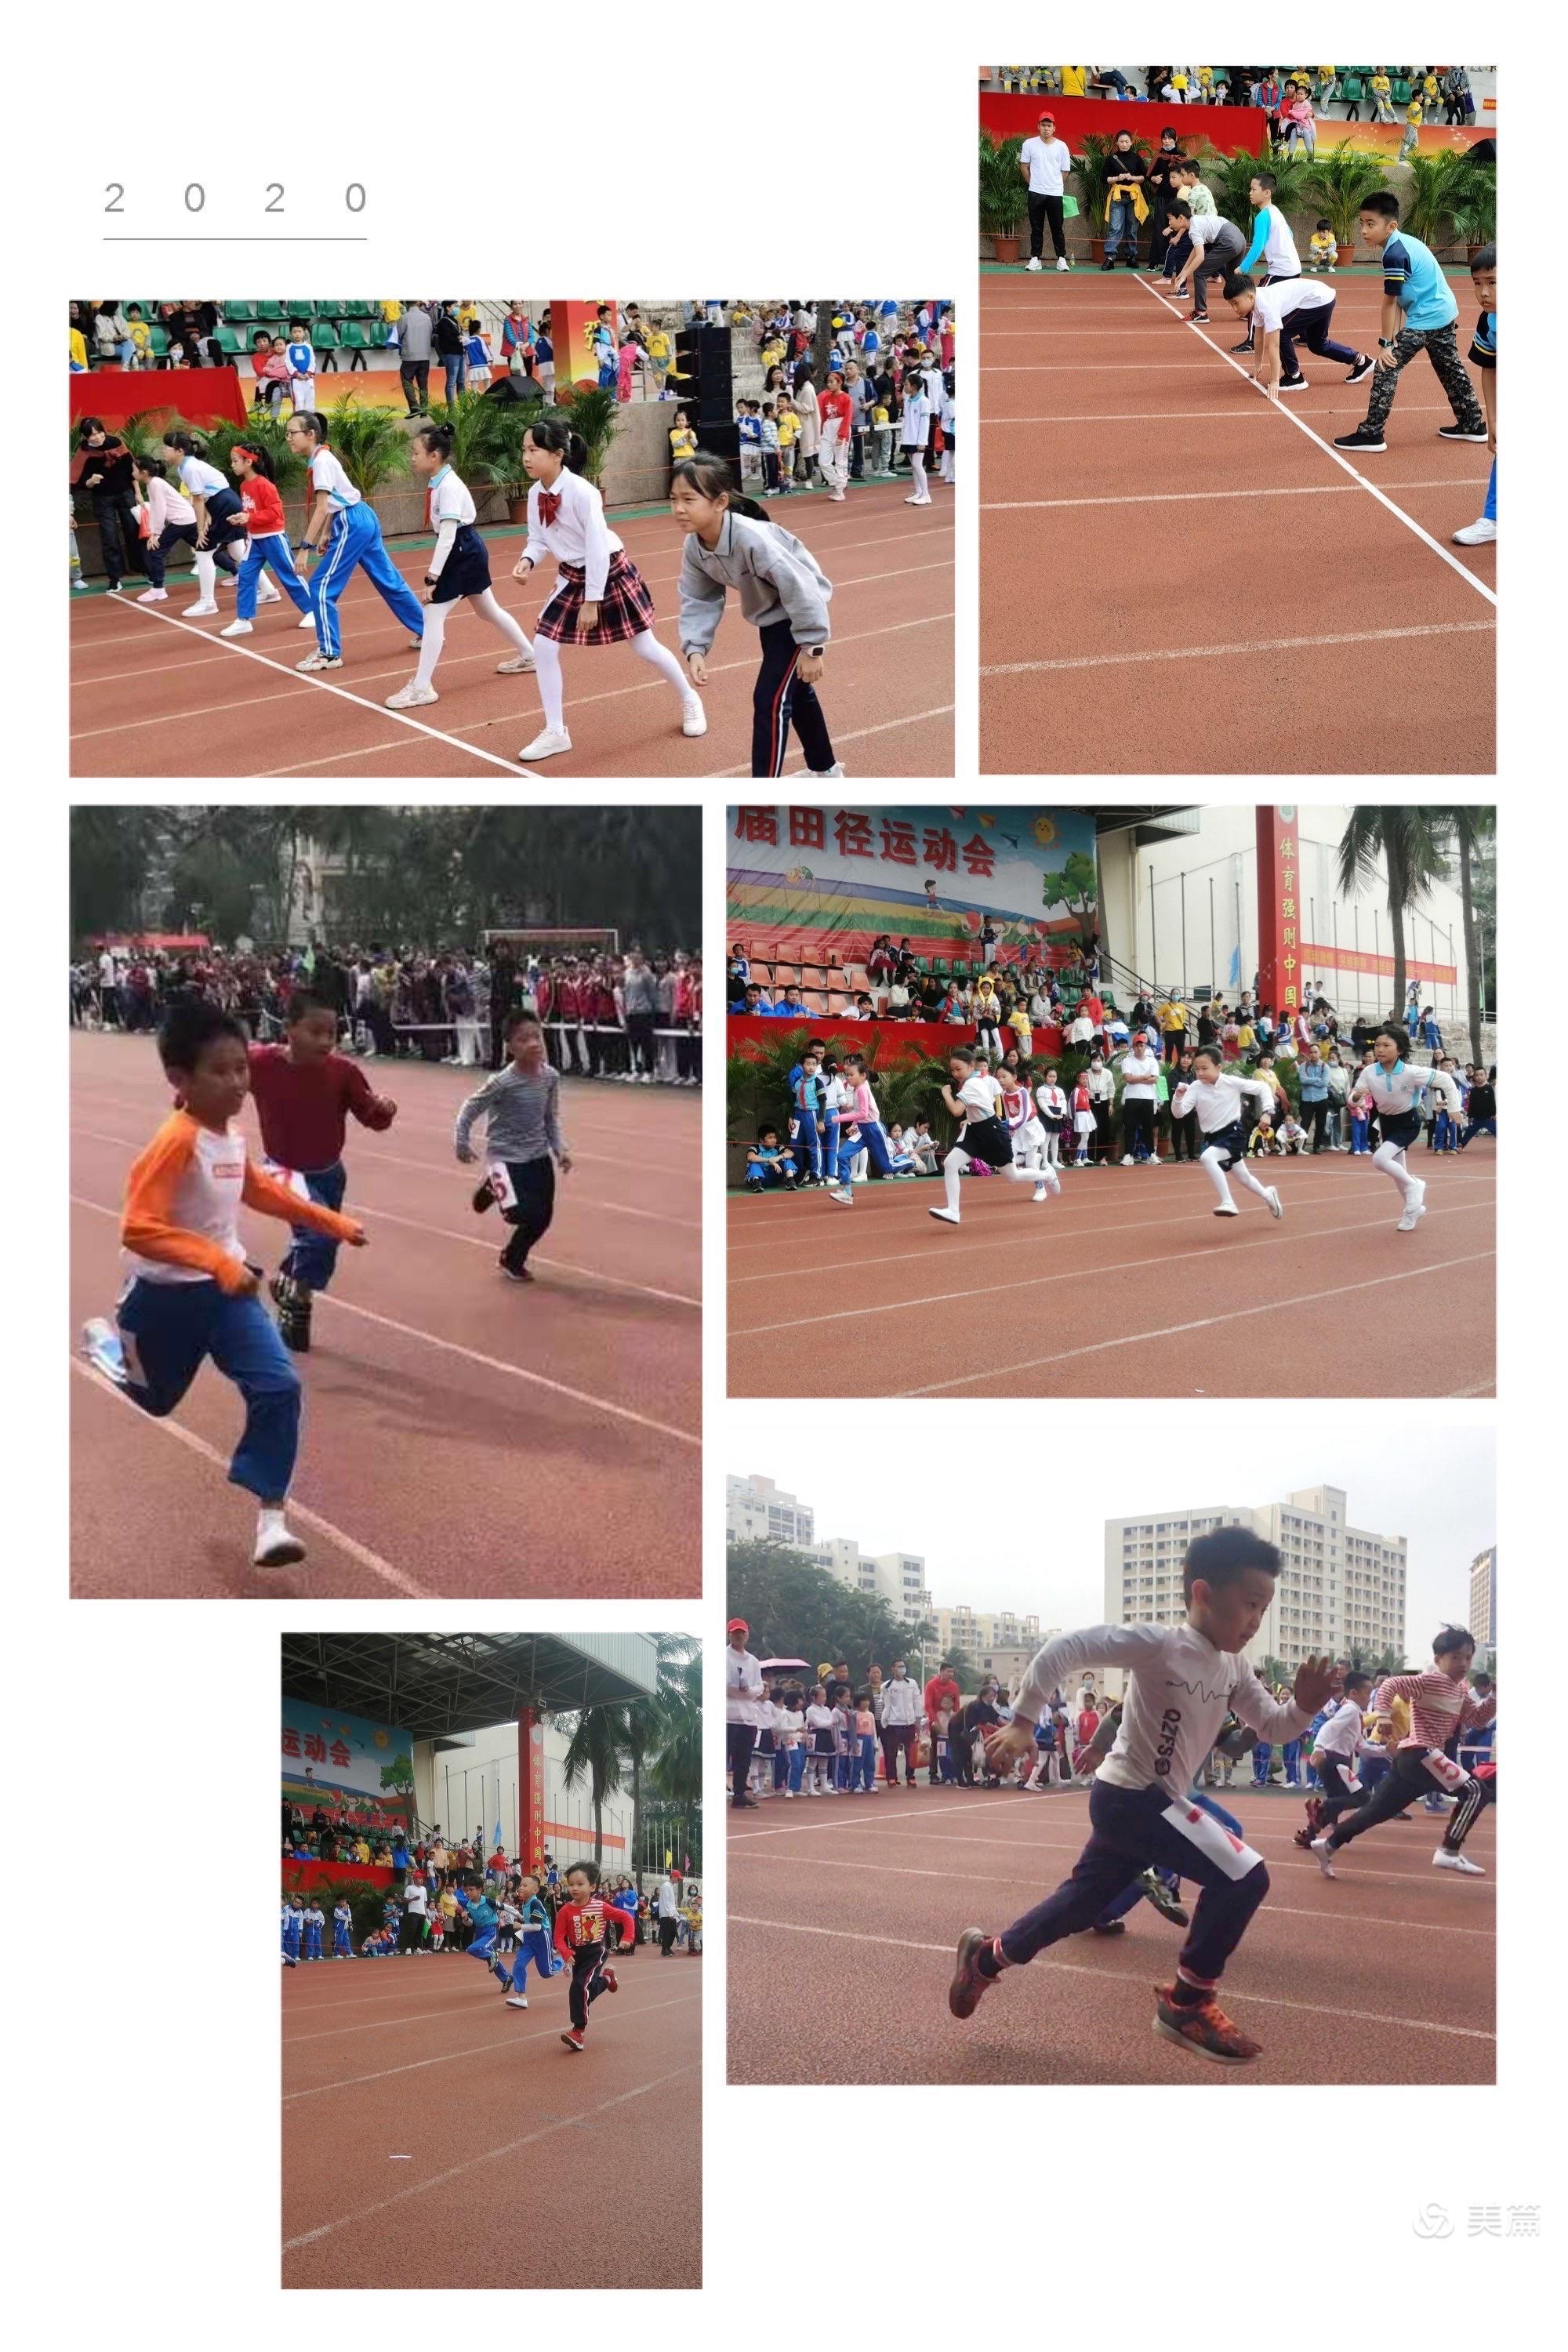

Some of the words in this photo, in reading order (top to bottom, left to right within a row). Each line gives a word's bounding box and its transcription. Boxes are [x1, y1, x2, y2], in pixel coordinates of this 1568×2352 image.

[281, 1727, 351, 1768] 运动会
[1433, 1755, 1461, 1781] 5
